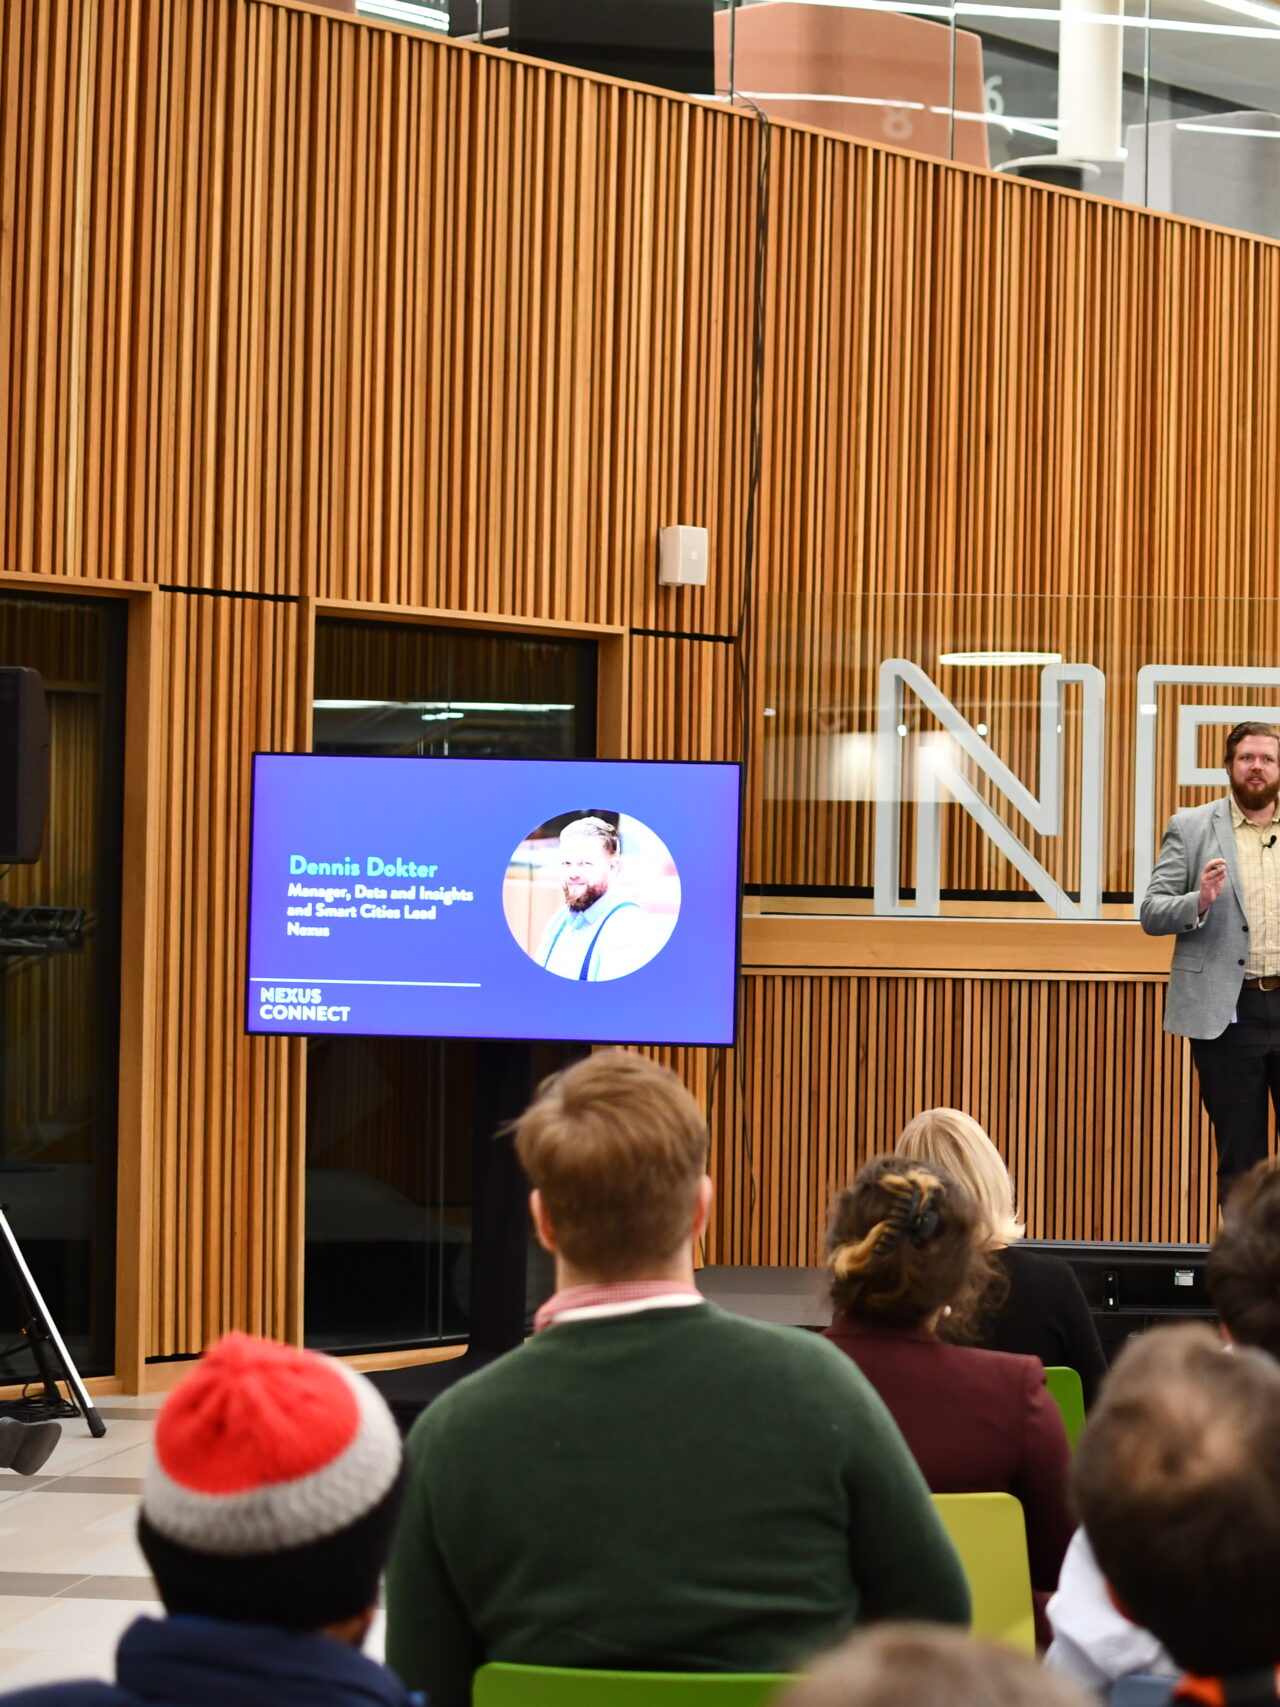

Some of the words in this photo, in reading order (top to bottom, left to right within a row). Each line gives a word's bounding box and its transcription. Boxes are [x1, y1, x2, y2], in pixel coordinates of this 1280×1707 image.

[290, 855, 360, 876] Dennis
[367, 856, 438, 878] Dokter
[288, 883, 351, 901] Manager,
[355, 884, 387, 899] Data
[390, 886, 416, 900] and
[419, 886, 474, 906] Insights
[287, 903, 312, 917] and
[315, 903, 357, 918] Smart
[360, 904, 401, 919] Cities
[404, 905, 436, 920] Lead
[287, 922, 330, 937] Nexus
[261, 987, 322, 1004] NEXUS
[260, 1005, 351, 1022] CONNECT
